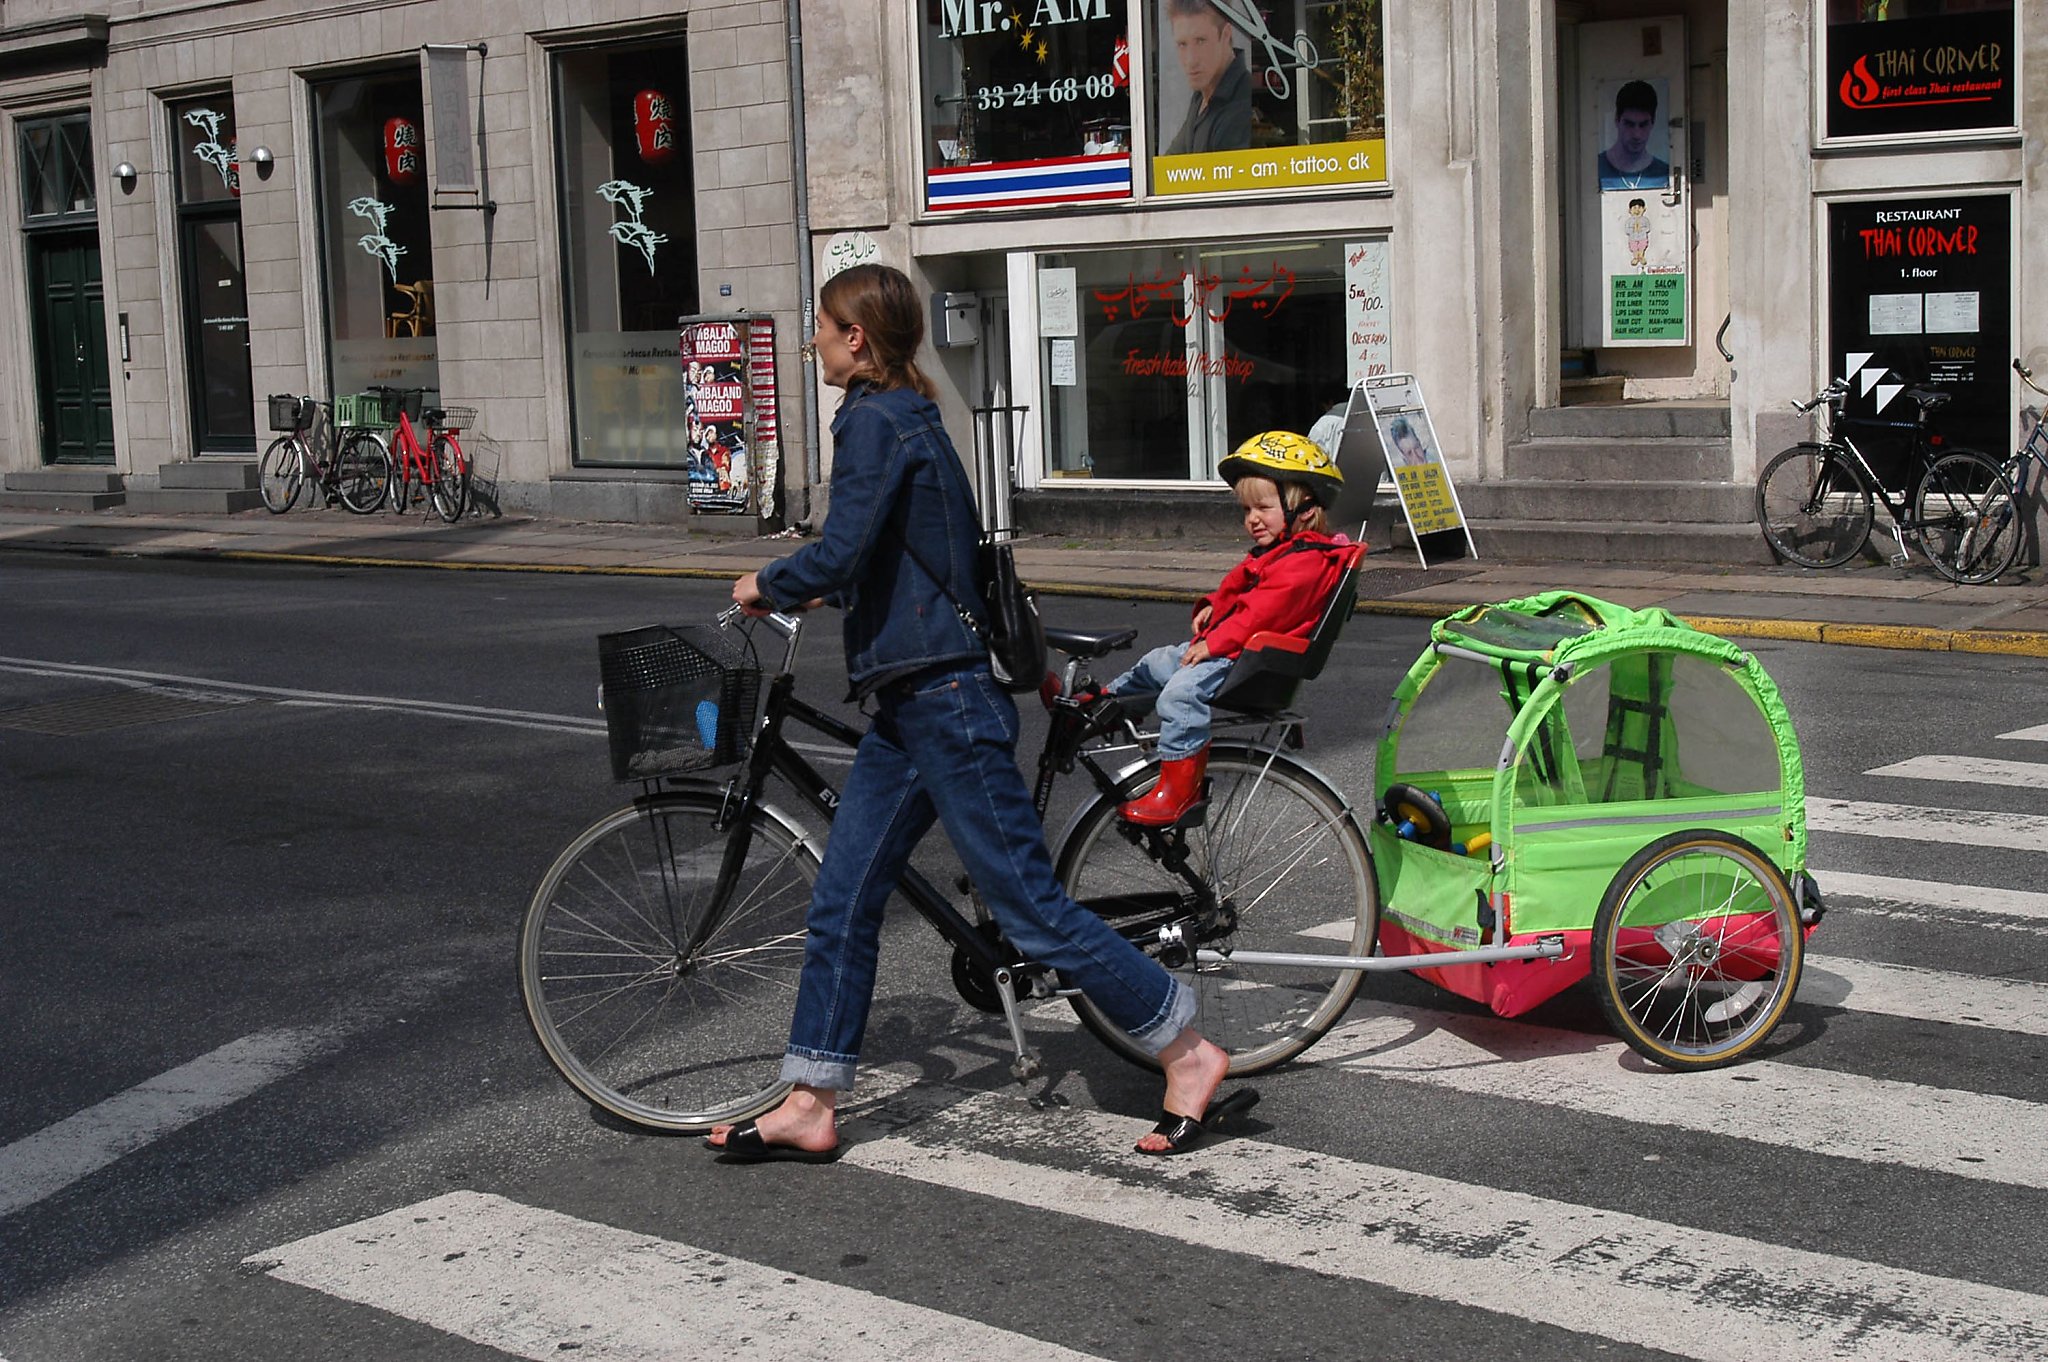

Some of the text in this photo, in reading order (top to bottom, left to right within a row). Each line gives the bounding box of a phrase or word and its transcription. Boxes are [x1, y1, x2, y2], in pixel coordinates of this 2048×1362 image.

[938, 0, 1111, 38] Mr. AM
[1923, 42, 2001, 75] CORNER
[977, 73, 1115, 110] 33 24 68 08
[1882, 78, 2002, 99] first class Thai restaurant
[1167, 165, 1205, 183] www.
[1213, 162, 1233, 180] mr
[1250, 160, 1279, 177] am
[1289, 155, 1342, 175] tattoo.
[1348, 152, 1370, 170] dk
[1876, 208, 1962, 224] RESTAURANT
[1907, 224, 1978, 256] CORNER
[1900, 267, 1938, 278] 1. floor
[1349, 284, 1356, 299] 5
[1632, 280, 1643, 288] AM
[1654, 279, 1678, 289] SALON
[683, 326, 737, 342] TIMBALAN
[695, 340, 730, 353] MAGOO
[698, 400, 732, 412] MAGOO
